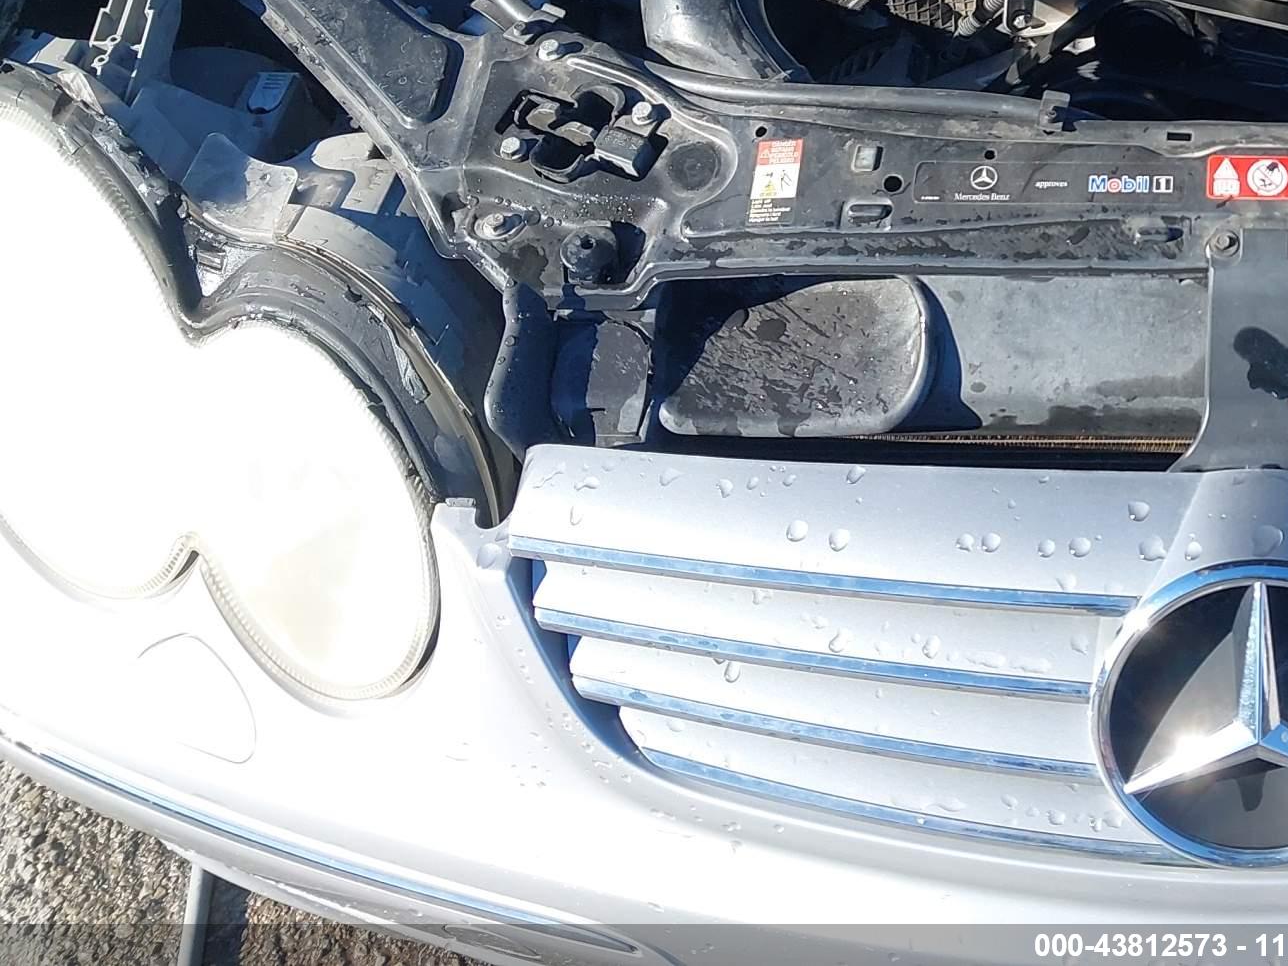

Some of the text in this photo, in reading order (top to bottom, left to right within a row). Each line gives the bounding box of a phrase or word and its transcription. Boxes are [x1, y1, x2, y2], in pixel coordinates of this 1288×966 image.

[1035, 180, 1069, 189] approves
[1087, 175, 1172, 193] Mobil 1
